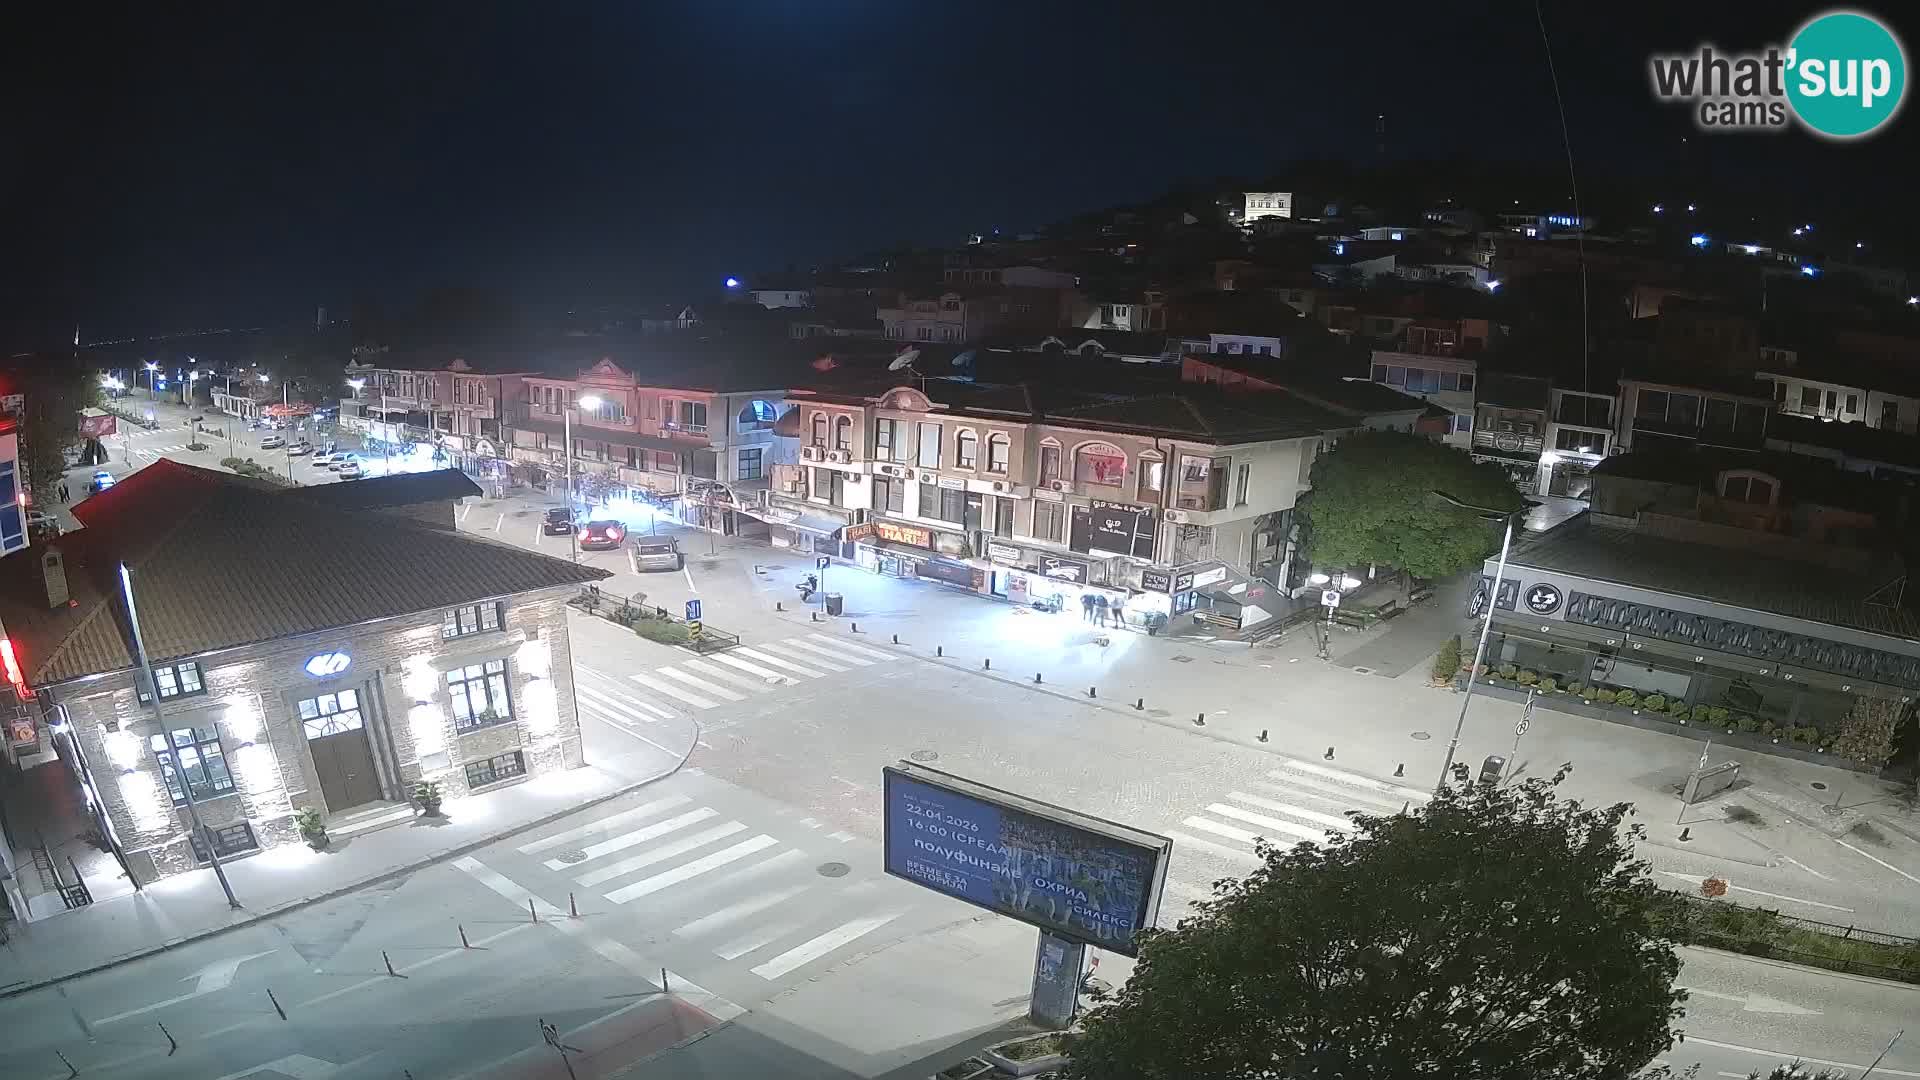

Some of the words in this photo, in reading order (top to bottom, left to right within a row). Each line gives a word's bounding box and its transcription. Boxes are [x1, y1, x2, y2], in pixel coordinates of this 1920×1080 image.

[883, 529, 918, 544] HARI
[819, 558, 828, 568] P
[907, 818, 947, 837] 16:00
[906, 859, 942, 877] ВРЕМЕ
[953, 875, 968, 885] ЗА
[1035, 878, 1087, 902] ОХРИД
[1073, 905, 1129, 927] СИЛЕКС
